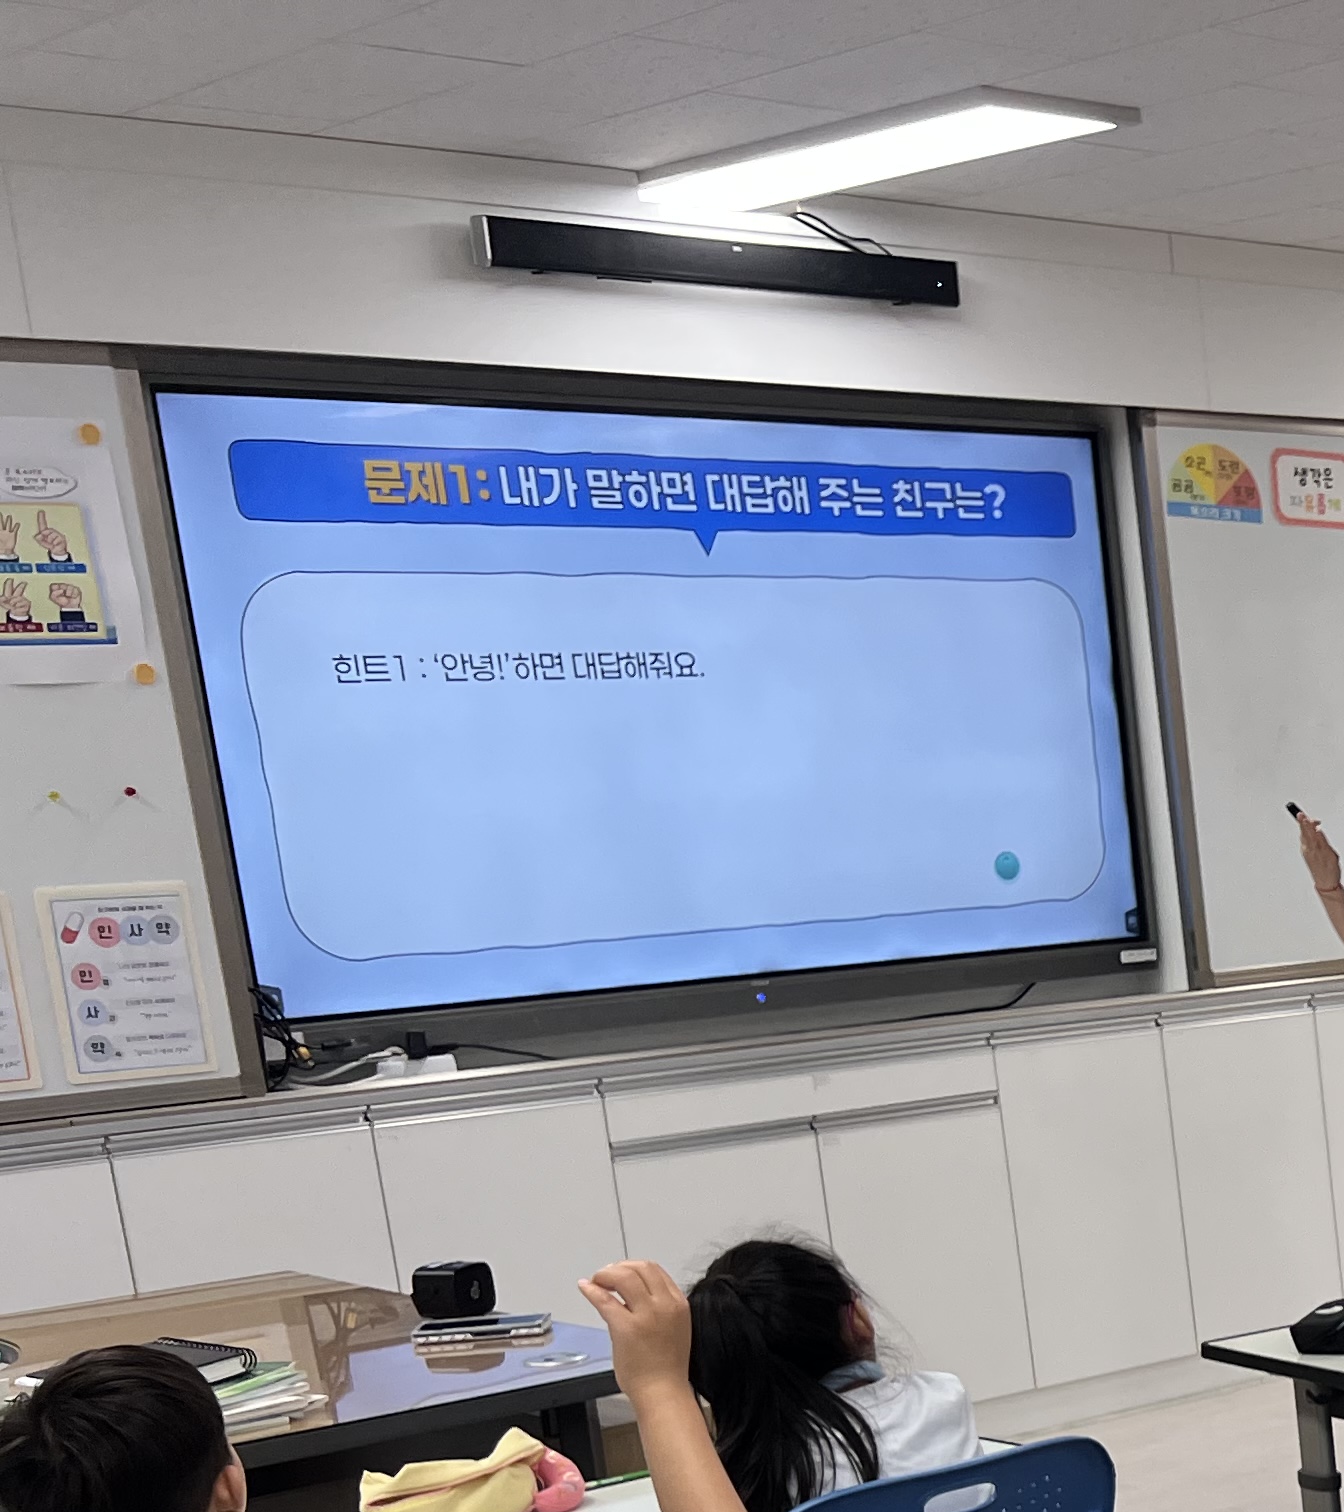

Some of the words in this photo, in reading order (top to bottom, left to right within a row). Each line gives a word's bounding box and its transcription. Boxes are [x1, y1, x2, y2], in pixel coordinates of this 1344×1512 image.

[363, 459, 492, 506] 문제1:
[498, 464, 579, 508] 내가
[585, 467, 699, 512] 말하면
[704, 472, 811, 515] 대답해
[817, 476, 885, 517] 주는
[891, 479, 1007, 520] 친구는?
[1293, 466, 1334, 489] 생각은
[332, 653, 406, 684] 힌트1
[571, 651, 706, 680] 대답해줘요.
